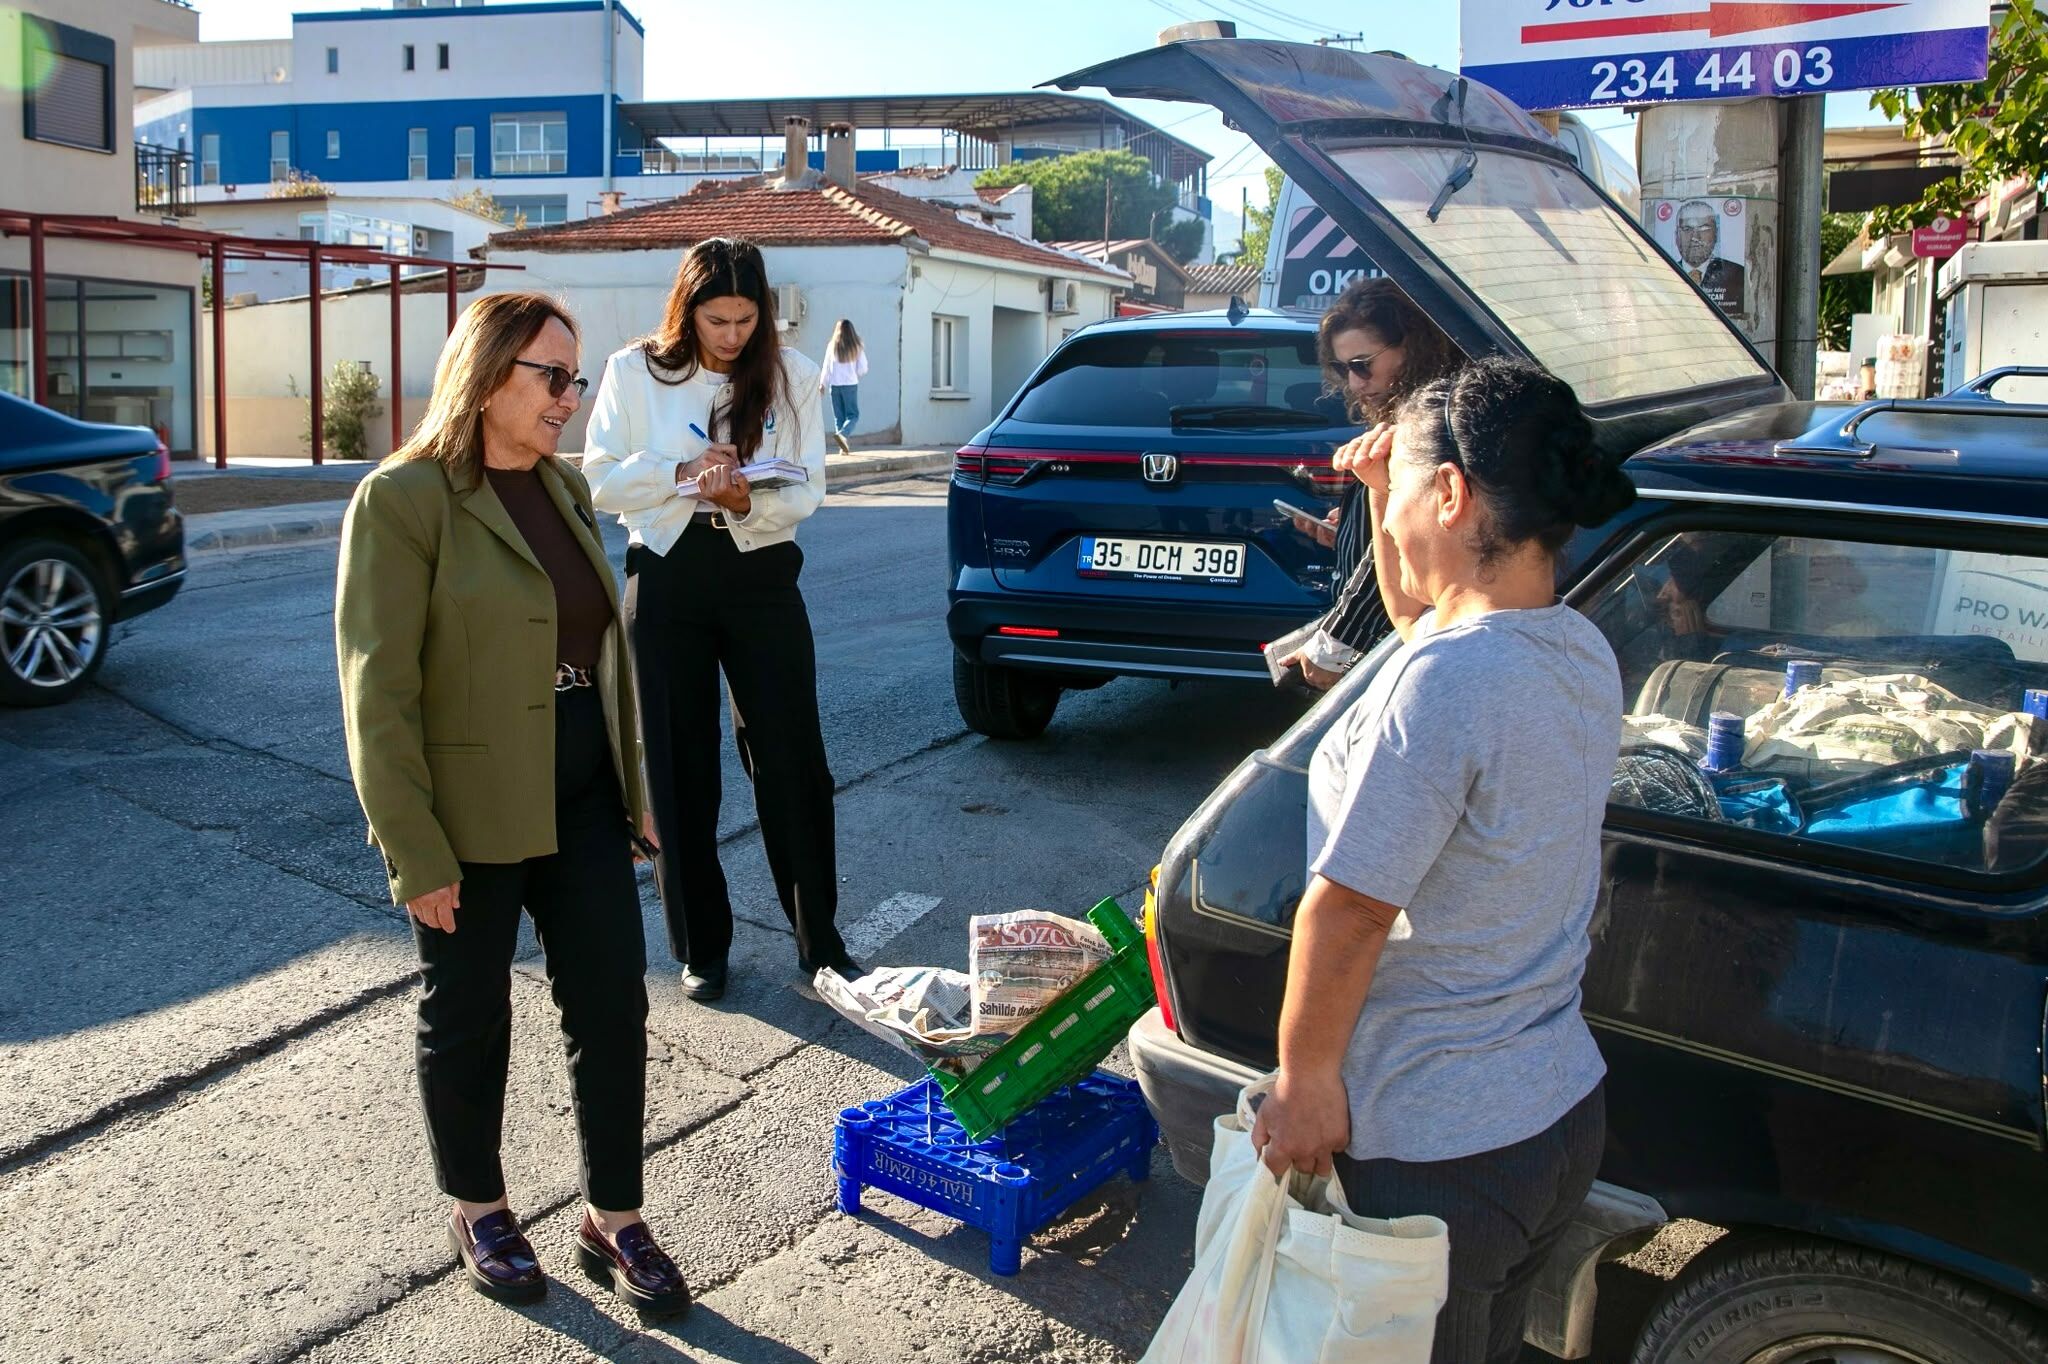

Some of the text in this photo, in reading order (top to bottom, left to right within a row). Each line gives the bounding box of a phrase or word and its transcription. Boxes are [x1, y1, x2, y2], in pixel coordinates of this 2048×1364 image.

[1590, 46, 1834, 101] 234 44 03
[1082, 542, 1238, 575] TR 35 DCM 398
[1957, 596, 2009, 620] PRO
[979, 1001, 1016, 1017] Sahilde
[919, 1172, 937, 1188] 46
[941, 1179, 974, 1202] HAL
[1682, 1293, 1796, 1361] TOURING
